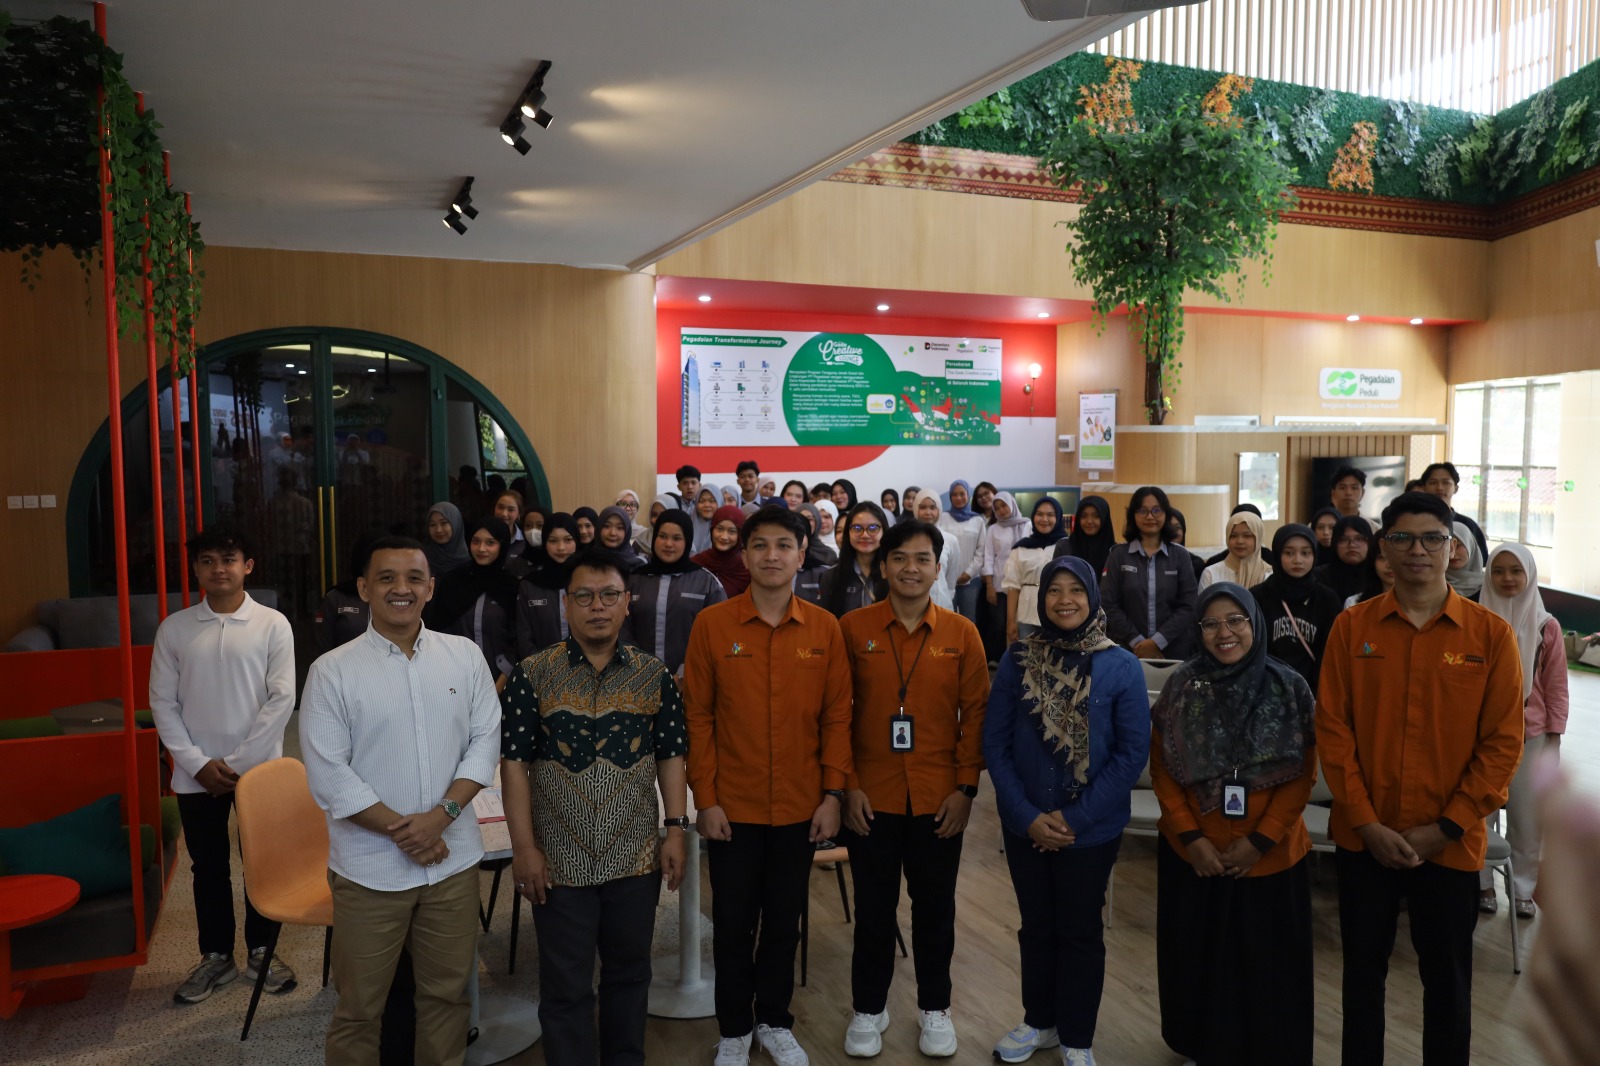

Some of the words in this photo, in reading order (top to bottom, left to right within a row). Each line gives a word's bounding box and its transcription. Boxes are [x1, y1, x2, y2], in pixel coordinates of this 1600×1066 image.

[682, 335, 713, 344] Pegadaian
[714, 336, 758, 344] Transformation
[759, 338, 782, 346] Journey
[818, 339, 863, 361] Creative
[839, 355, 860, 363] LOUNGE
[1359, 373, 1395, 385] Pegadaian
[1359, 387, 1379, 397] Peduli
